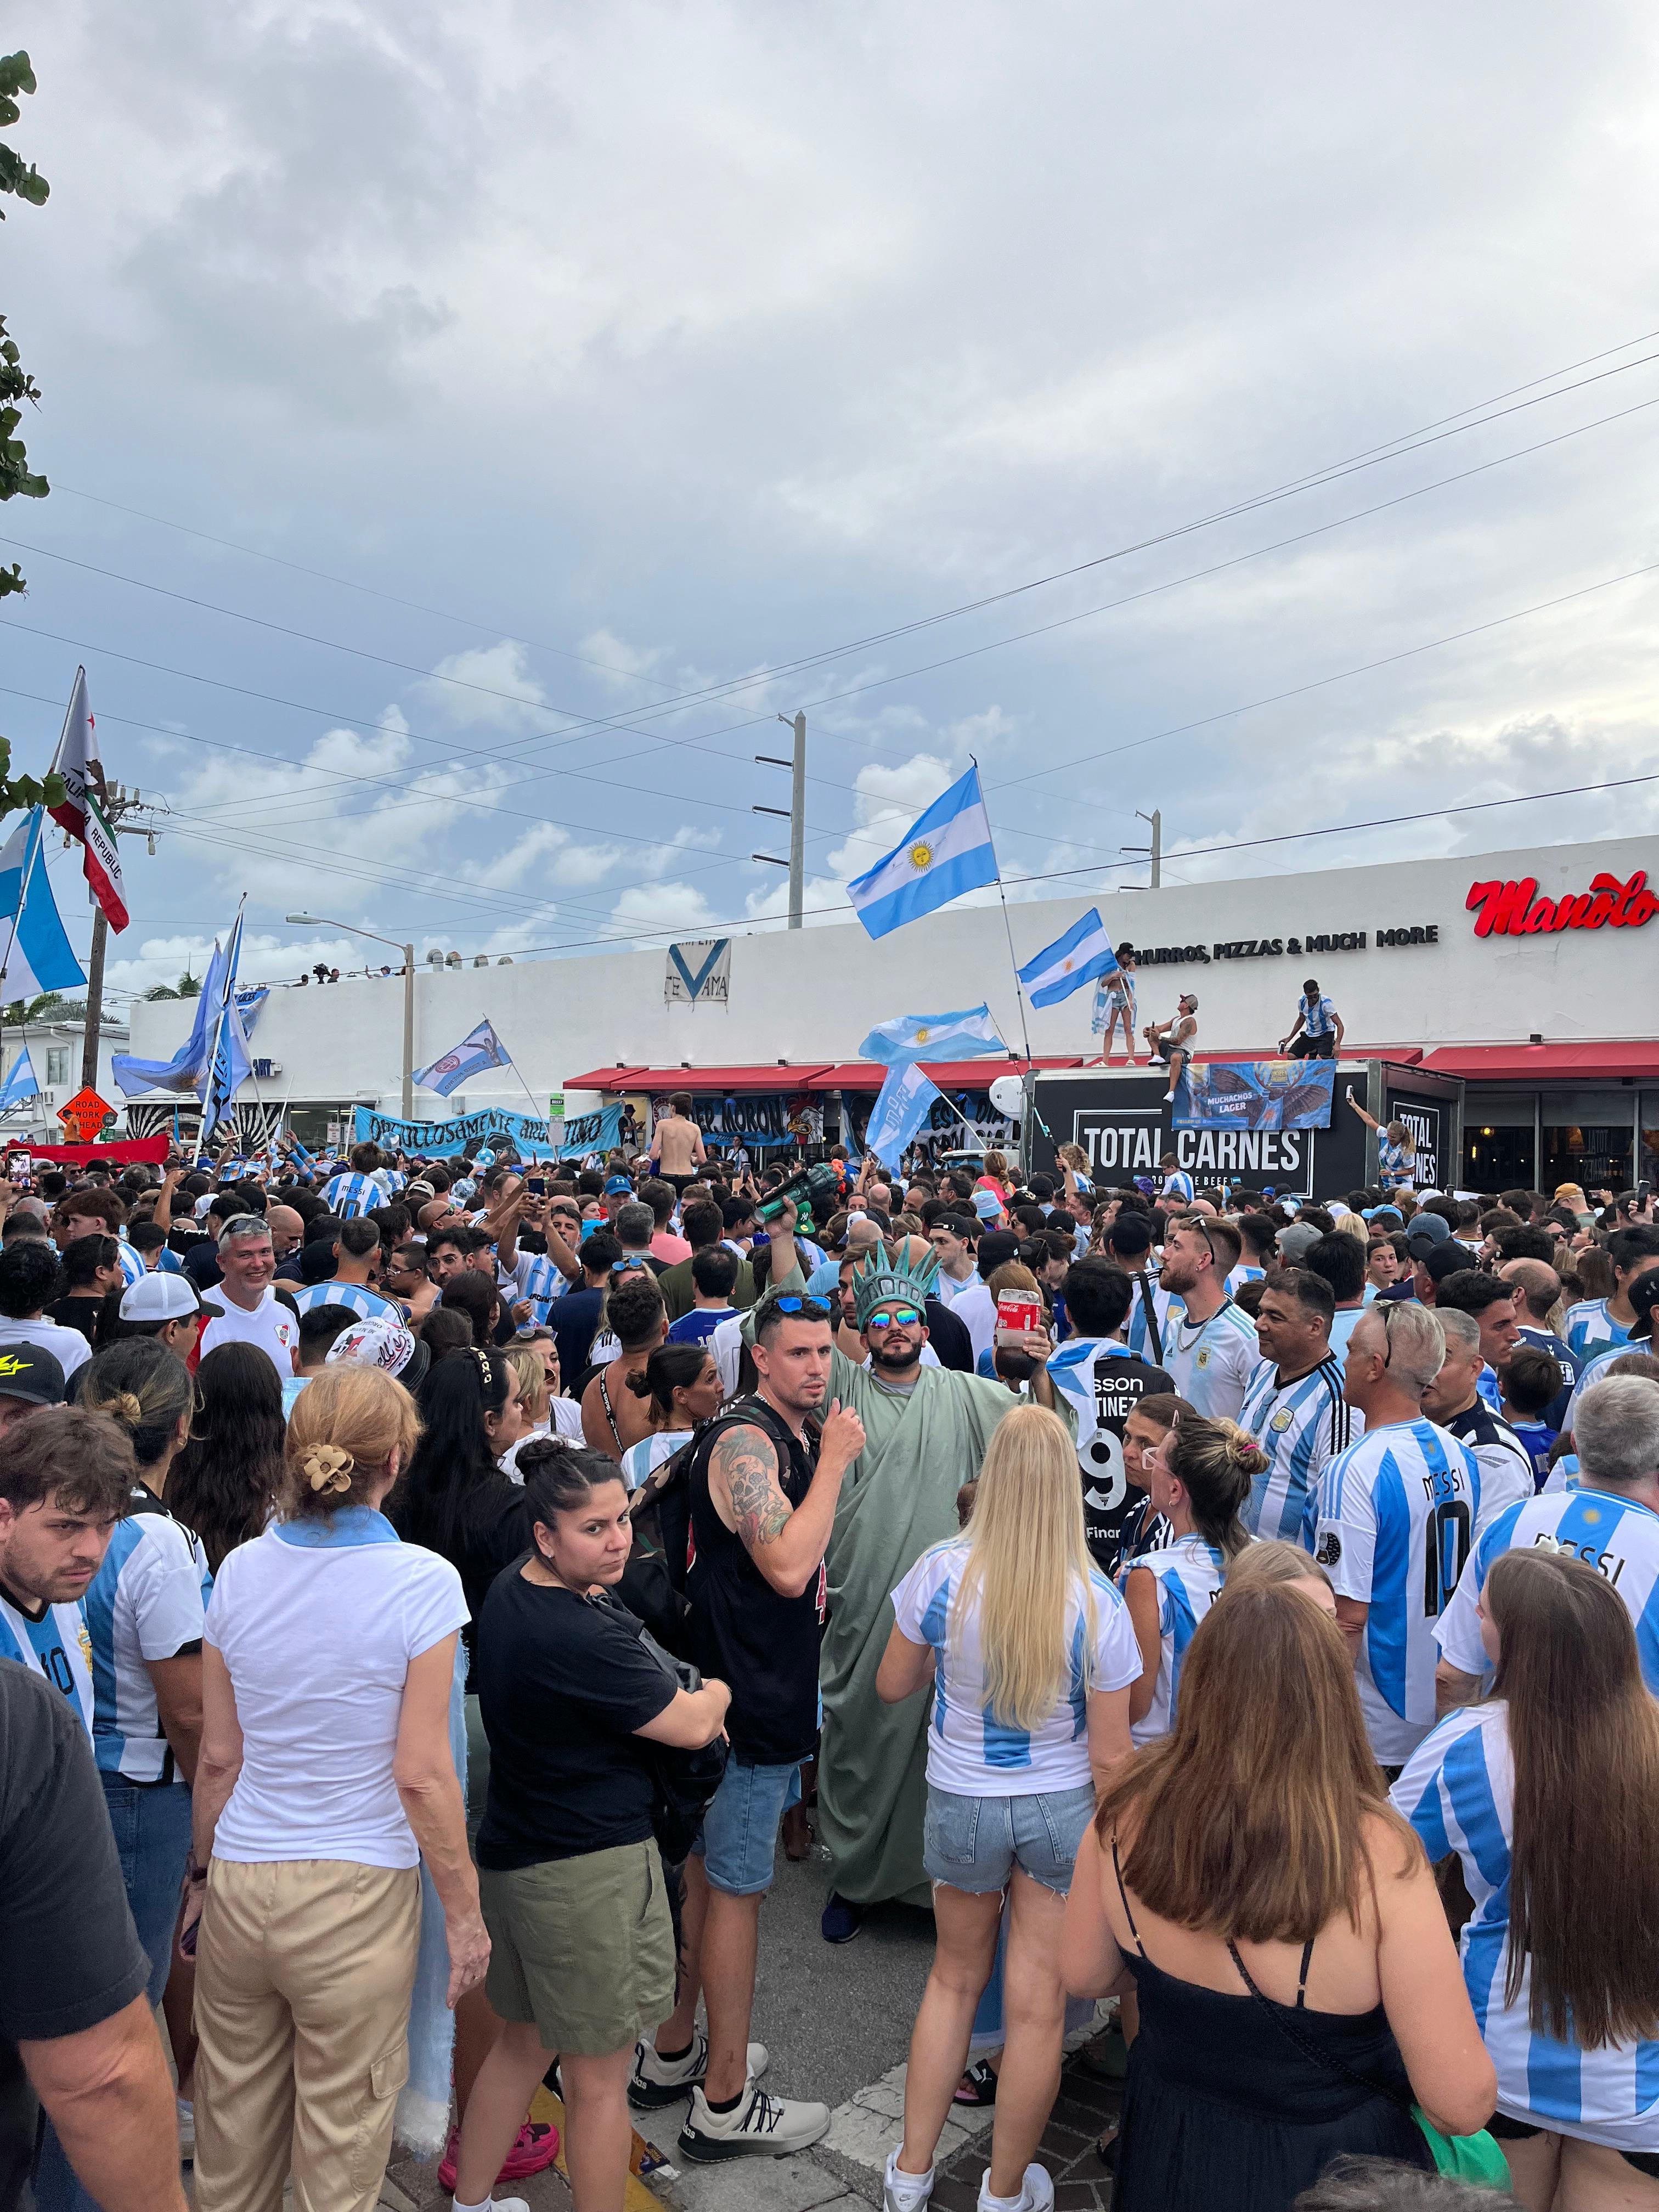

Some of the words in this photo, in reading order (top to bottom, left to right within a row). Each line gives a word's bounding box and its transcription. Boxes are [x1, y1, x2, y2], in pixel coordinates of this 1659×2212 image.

[91, 828, 122, 879] REPUBLIC
[1135, 944, 1210, 966] HURROS,
[1214, 939, 1283, 960] PIZZAS
[1286, 938, 1303, 955] &
[1306, 932, 1366, 952] MUCH
[1376, 924, 1438, 947] MORE
[701, 976, 728, 997] AMA
[1207, 1092, 1252, 1105] MUCHACHOS
[1219, 1102, 1246, 1114] LAGER
[1400, 1113, 1432, 1148] TOTAL
[1084, 1127, 1161, 1169] TOTAL
[1177, 1129, 1301, 1171] CARNES
[1412, 1152, 1436, 1184] NES
[341, 1185, 366, 1195] MESSI
[1204, 1176, 1228, 1186] BEEF
[336, 1197, 362, 1220] 10
[1094, 1376, 1143, 1392] sson
[1096, 1396, 1138, 1417] TINEZ
[1077, 1427, 1127, 1510] 9
[1422, 1467, 1465, 1502] MESSI
[1424, 1499, 1471, 1618] 10
[632, 2075, 647, 2090] das
[682, 2124, 696, 2139] das
